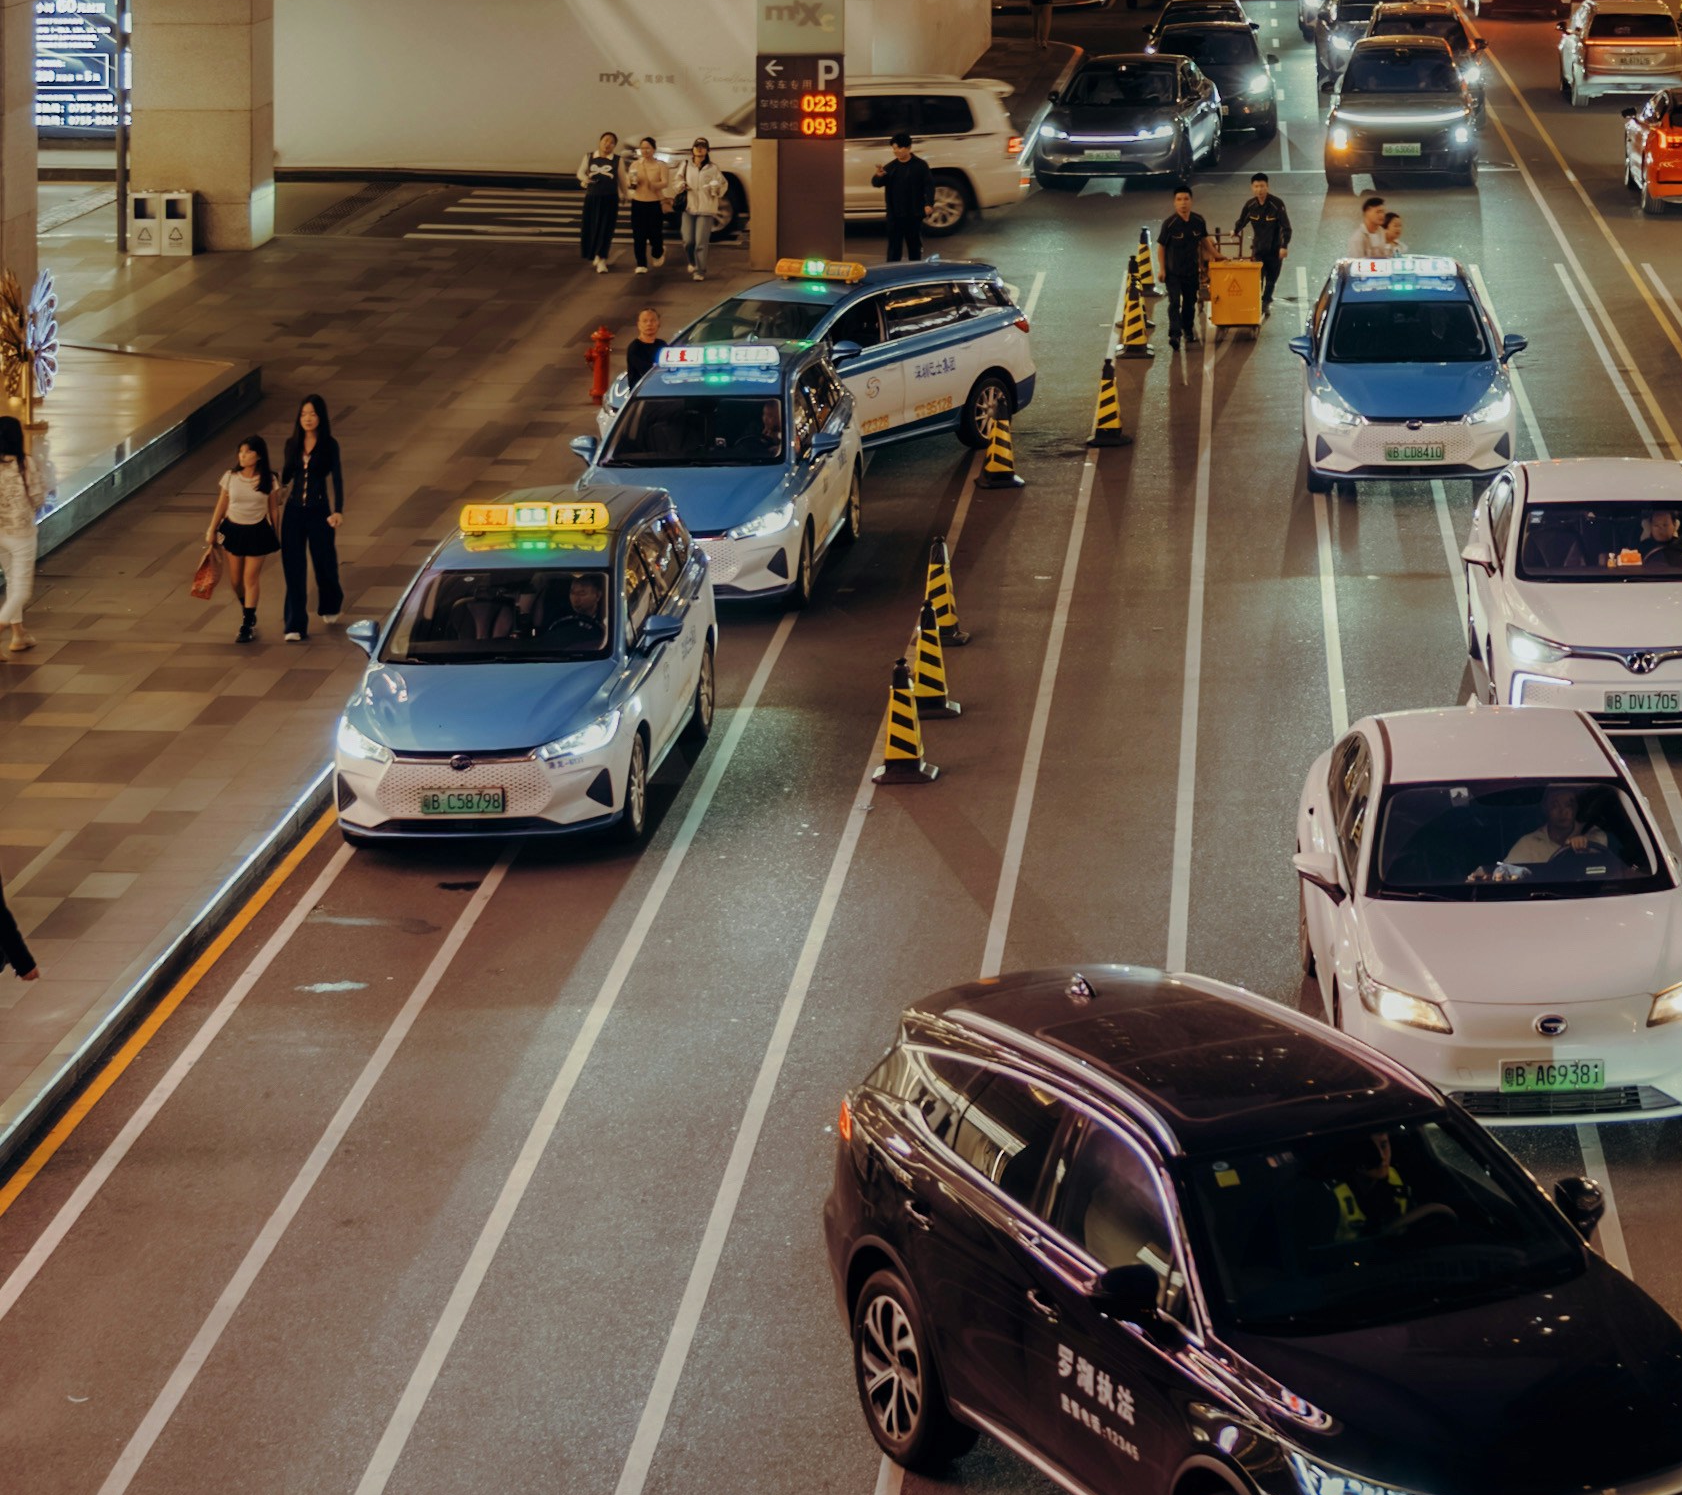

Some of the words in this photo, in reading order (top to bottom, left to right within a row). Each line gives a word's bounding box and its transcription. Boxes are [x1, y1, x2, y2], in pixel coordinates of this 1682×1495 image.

[818, 60, 840, 91] P
[764, 79, 813, 91] 客车专用
[802, 95, 838, 113] 023
[802, 117, 838, 135] 093
[1404, 446, 1442, 458] CD8410
[1628, 693, 1679, 710] DV1705
[447, 792, 501, 811] C58798
[1058, 1343, 1136, 1426] 罗湖执法
